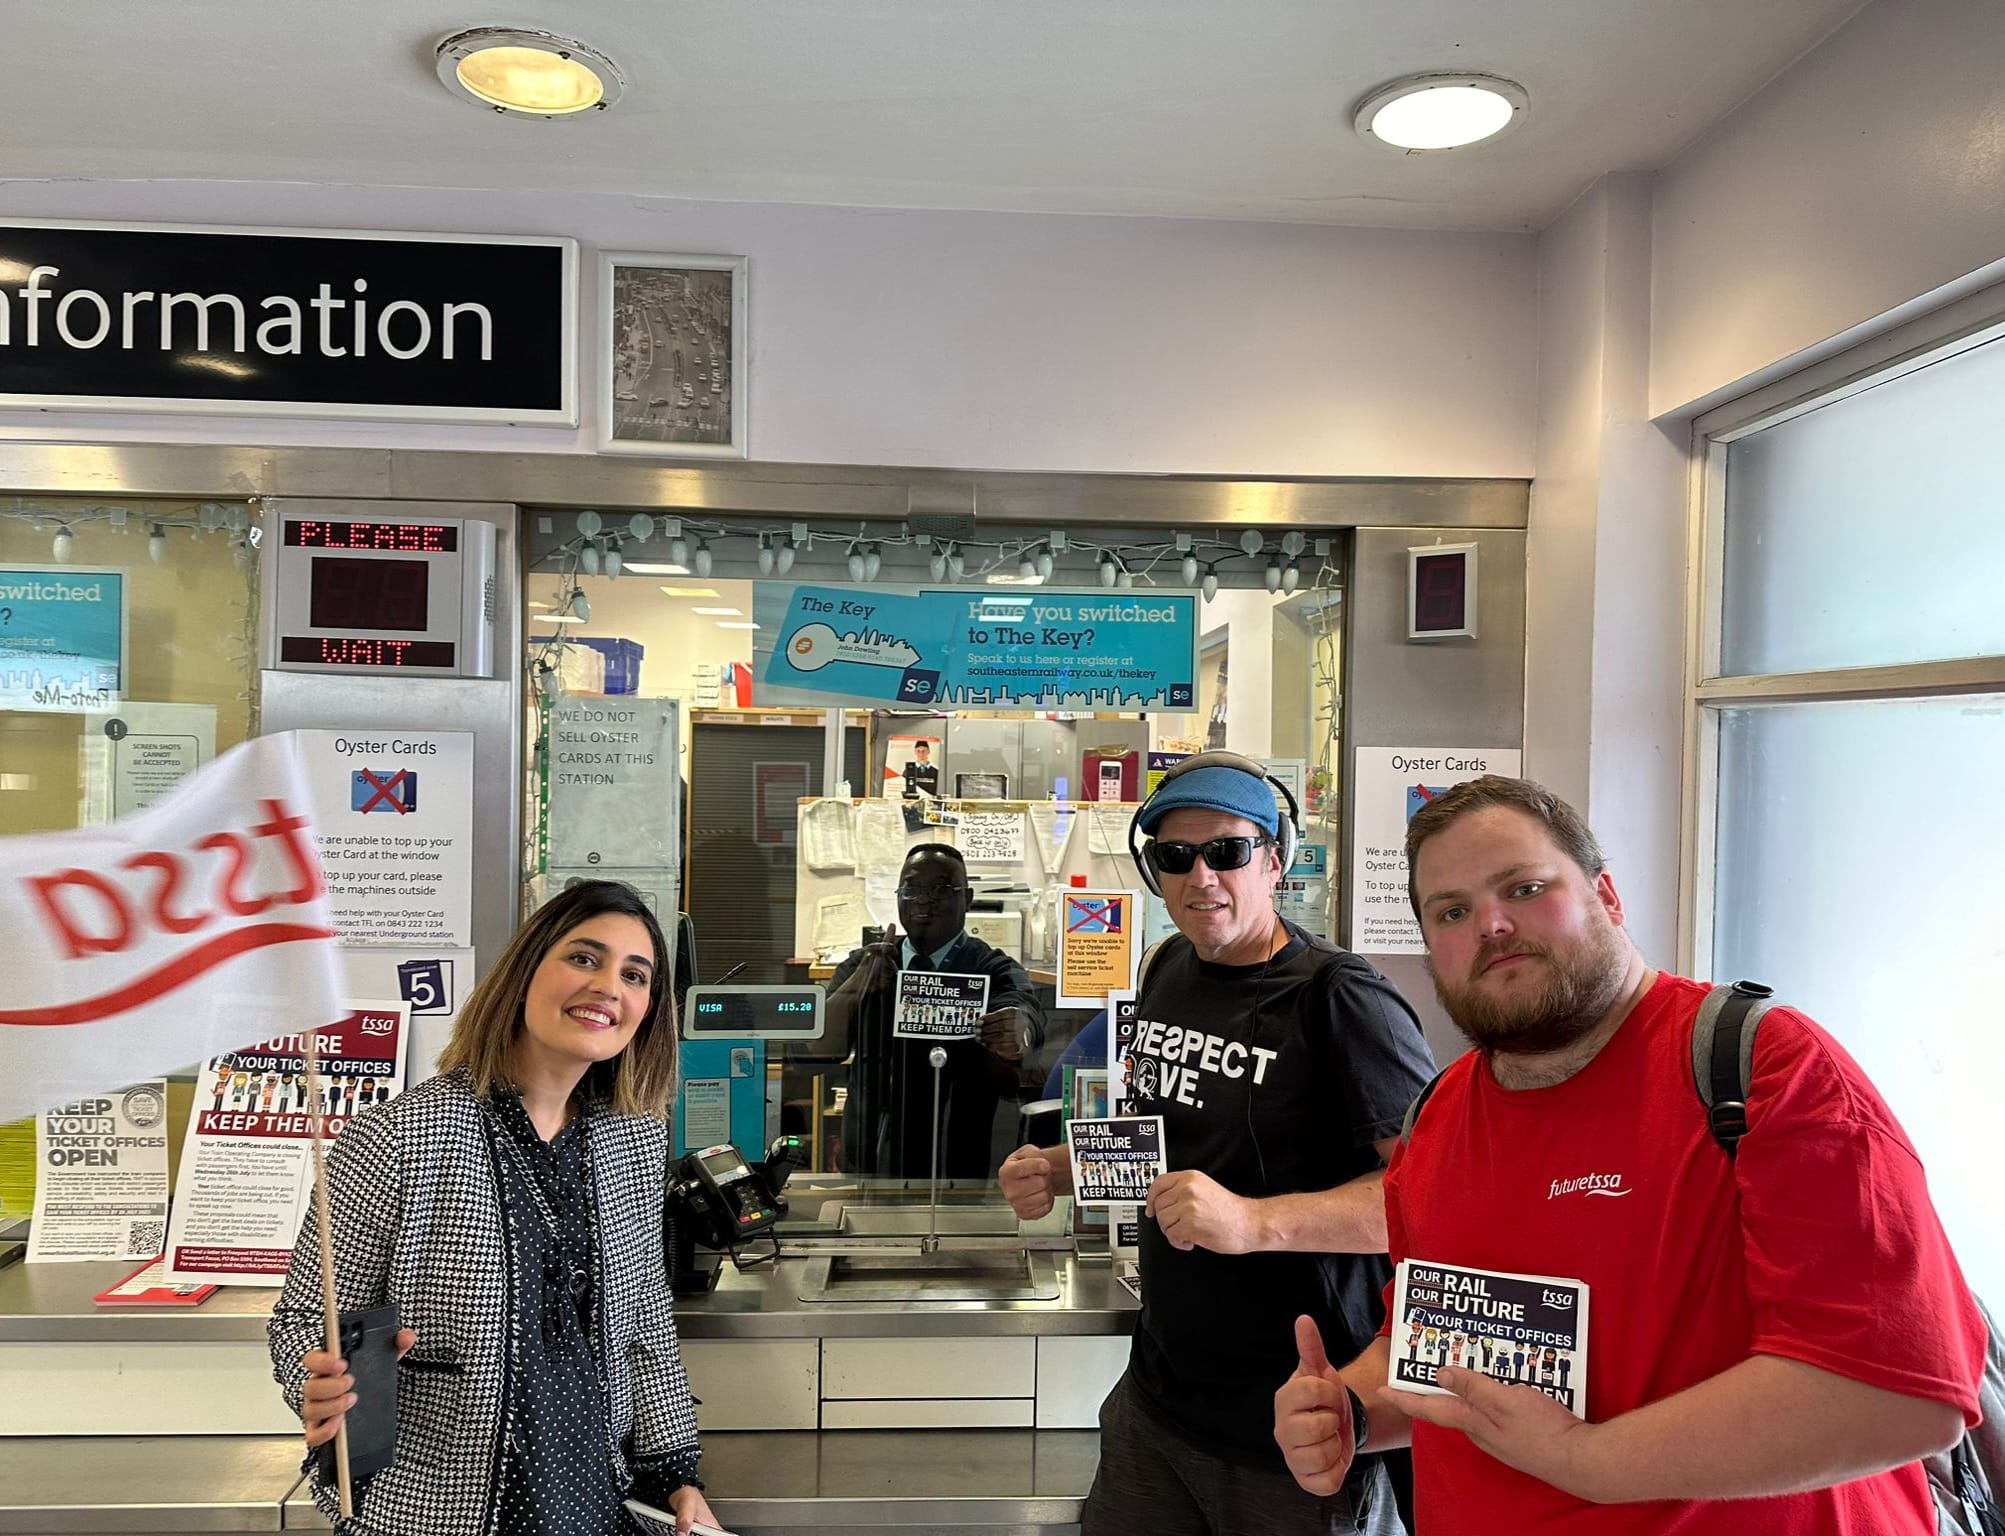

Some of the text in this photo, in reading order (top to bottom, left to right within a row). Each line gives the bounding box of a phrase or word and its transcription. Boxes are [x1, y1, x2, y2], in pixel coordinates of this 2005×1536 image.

[0, 265, 492, 361] formation
[300, 521, 444, 551] PLEASE
[801, 596, 876, 620] The Key
[968, 601, 1176, 624] Have you switched
[968, 627, 1095, 650] to The Key?
[321, 638, 412, 665] WAIT
[968, 653, 1134, 667] Speak to us here or register at
[968, 666, 1156, 680] southeasternrailway.co.uk/thekey
[904, 678, 931, 694] se
[559, 711, 636, 723] WE DO NOT
[559, 732, 639, 743] SELL OYSTER
[335, 738, 437, 757] Oyster Cards
[559, 752, 654, 765] CARDS AT THIS
[1391, 755, 1487, 773] Oyster Cards
[559, 774, 614, 785] STATION
[326, 836, 453, 849] are unable to top up your
[343, 849, 440, 861] Card at the window
[1304, 851, 1313, 863] 5
[1366, 847, 1380, 857] We
[1382, 848, 1398, 857] are
[1366, 861, 1396, 872] Oyster
[324, 871, 340, 881] top
[343, 872, 355, 882] up
[357, 872, 380, 882] your
[410, 872, 443, 882] please
[329, 885, 345, 895] the
[398, 885, 437, 896] outside
[1365, 880, 1377, 890] To
[1379, 881, 1396, 892] top
[1365, 895, 1382, 904] use
[1384, 894, 1400, 904] the
[349, 909, 365, 919] help
[366, 910, 383, 918] with
[384, 911, 400, 919] your
[401, 910, 426, 919] Oyster
[427, 910, 445, 918] Card
[408, 920, 422, 928] 222
[424, 920, 444, 928] 1234
[1364, 917, 1370, 926] If
[1371, 919, 1384, 928] you
[1385, 917, 1403, 926] need
[350, 929, 454, 940] nearest Underground station
[1364, 926, 1387, 936] please
[1387, 928, 1414, 936] contact
[1364, 937, 1403, 946] or visit your
[920, 976, 944, 987] RAIL
[411, 972, 435, 1006] 5
[919, 986, 960, 997] FUTURE
[699, 1003, 722, 1012] VISA
[931, 998, 954, 1006] TICKET
[955, 999, 982, 1007] OFFICES
[361, 1015, 395, 1032] tssa
[900, 1023, 925, 1032] KEEP
[926, 1024, 953, 1034] THEM
[1130, 1020, 1278, 1085] RESPECT
[237, 1056, 277, 1070] YOUR
[332, 1060, 392, 1075] OFFICES
[49, 1118, 114, 1135] YOUR
[204, 1113, 259, 1131] KEEP
[1139, 1124, 1156, 1133] tssa
[1073, 1124, 1113, 1137] OUR RAIL
[47, 1136, 165, 1148] TICKET OFFICES
[1075, 1136, 1132, 1149] OUR FUTURE
[48, 1149, 118, 1167] OPEN
[1087, 1151, 1158, 1160] YOUR TICKET OFFICES
[1082, 1187, 1106, 1198] KEEP
[1106, 1187, 1134, 1198] THEM
[1547, 1172, 1622, 1200] futuretssa
[1413, 1269, 1492, 1298] OUR RAIL
[1542, 1289, 1573, 1307] tssa
[1411, 1288, 1525, 1322] OUR FUTURE
[1427, 1312, 1572, 1347] YOUR TICKET OFFICES
[1403, 1361, 1437, 1381] KEE
